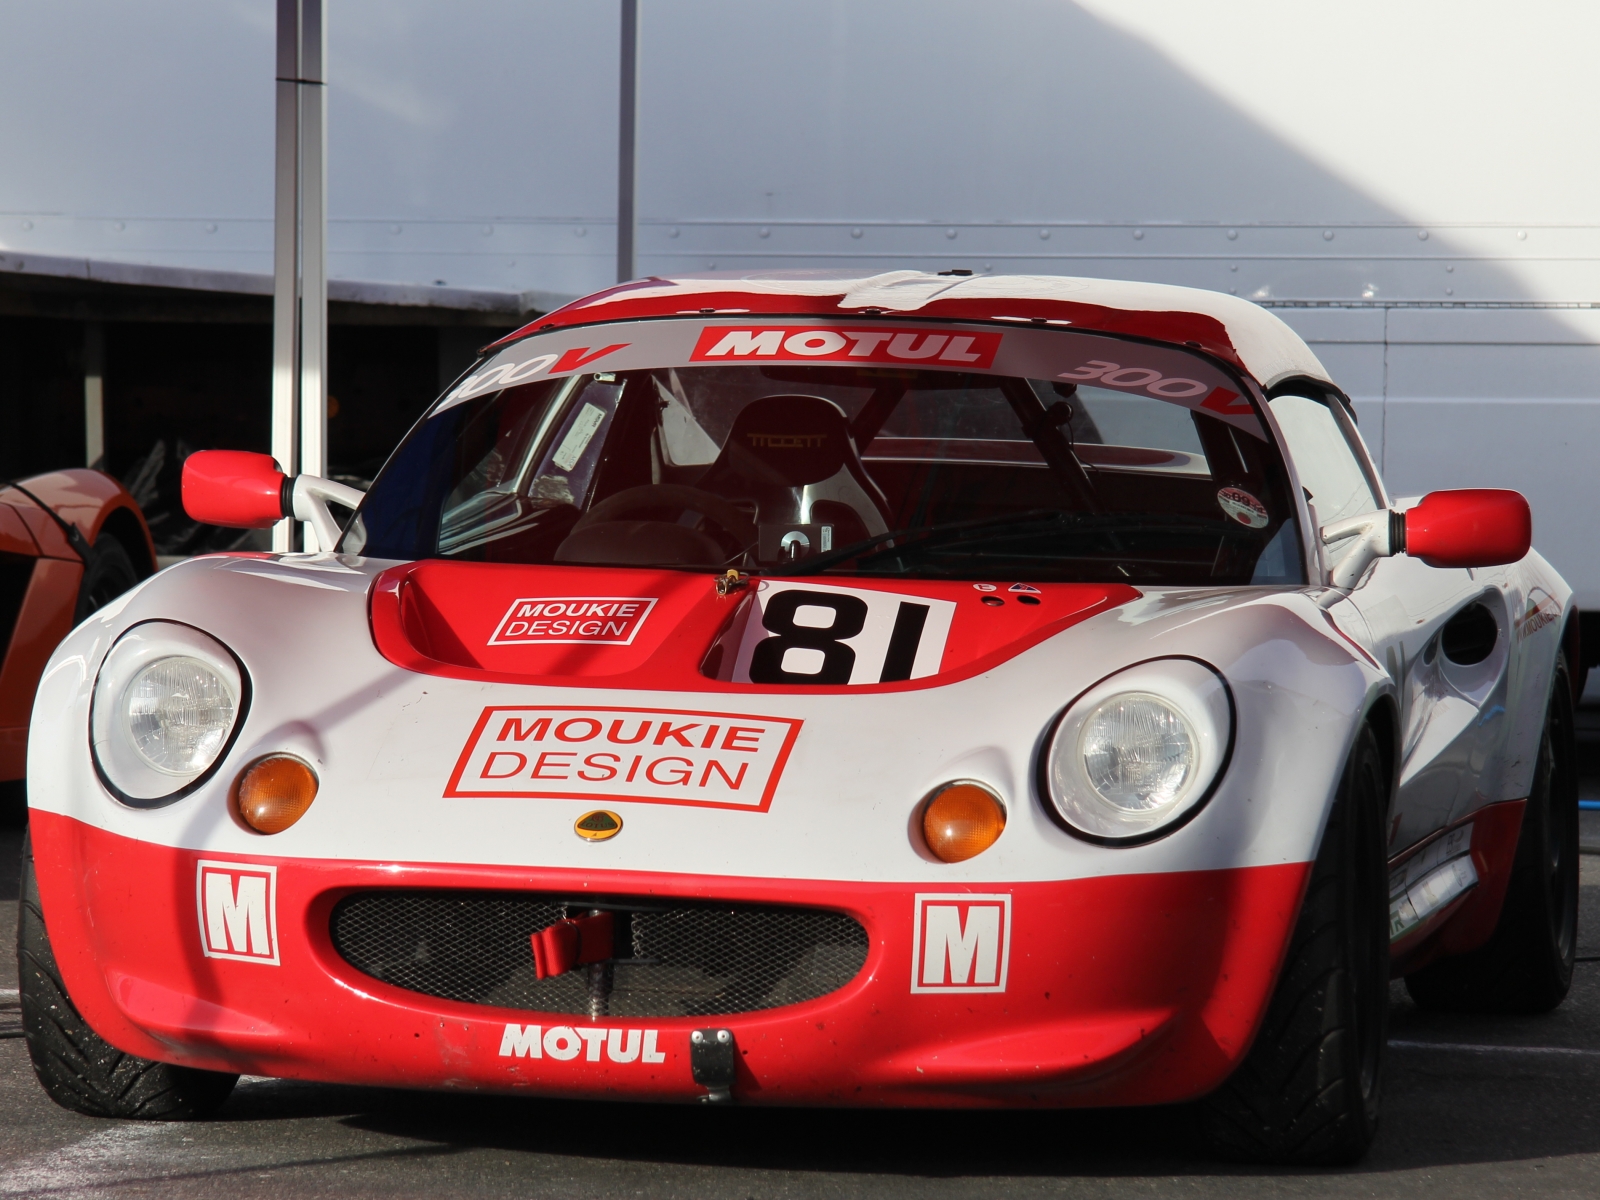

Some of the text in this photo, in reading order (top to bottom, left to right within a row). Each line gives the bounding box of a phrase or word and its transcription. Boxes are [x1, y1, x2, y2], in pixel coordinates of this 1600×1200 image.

[705, 330, 982, 363] MOTUL
[1057, 359, 1255, 415] 300V
[504, 620, 627, 636] DESIGN
[516, 603, 640, 618] MOUKIE
[749, 589, 931, 685] 81
[496, 717, 766, 753] MOUKIE
[479, 751, 749, 790] DESIGN
[205, 871, 271, 956] M
[922, 905, 1001, 984] M
[499, 1022, 666, 1064] MOTUL
